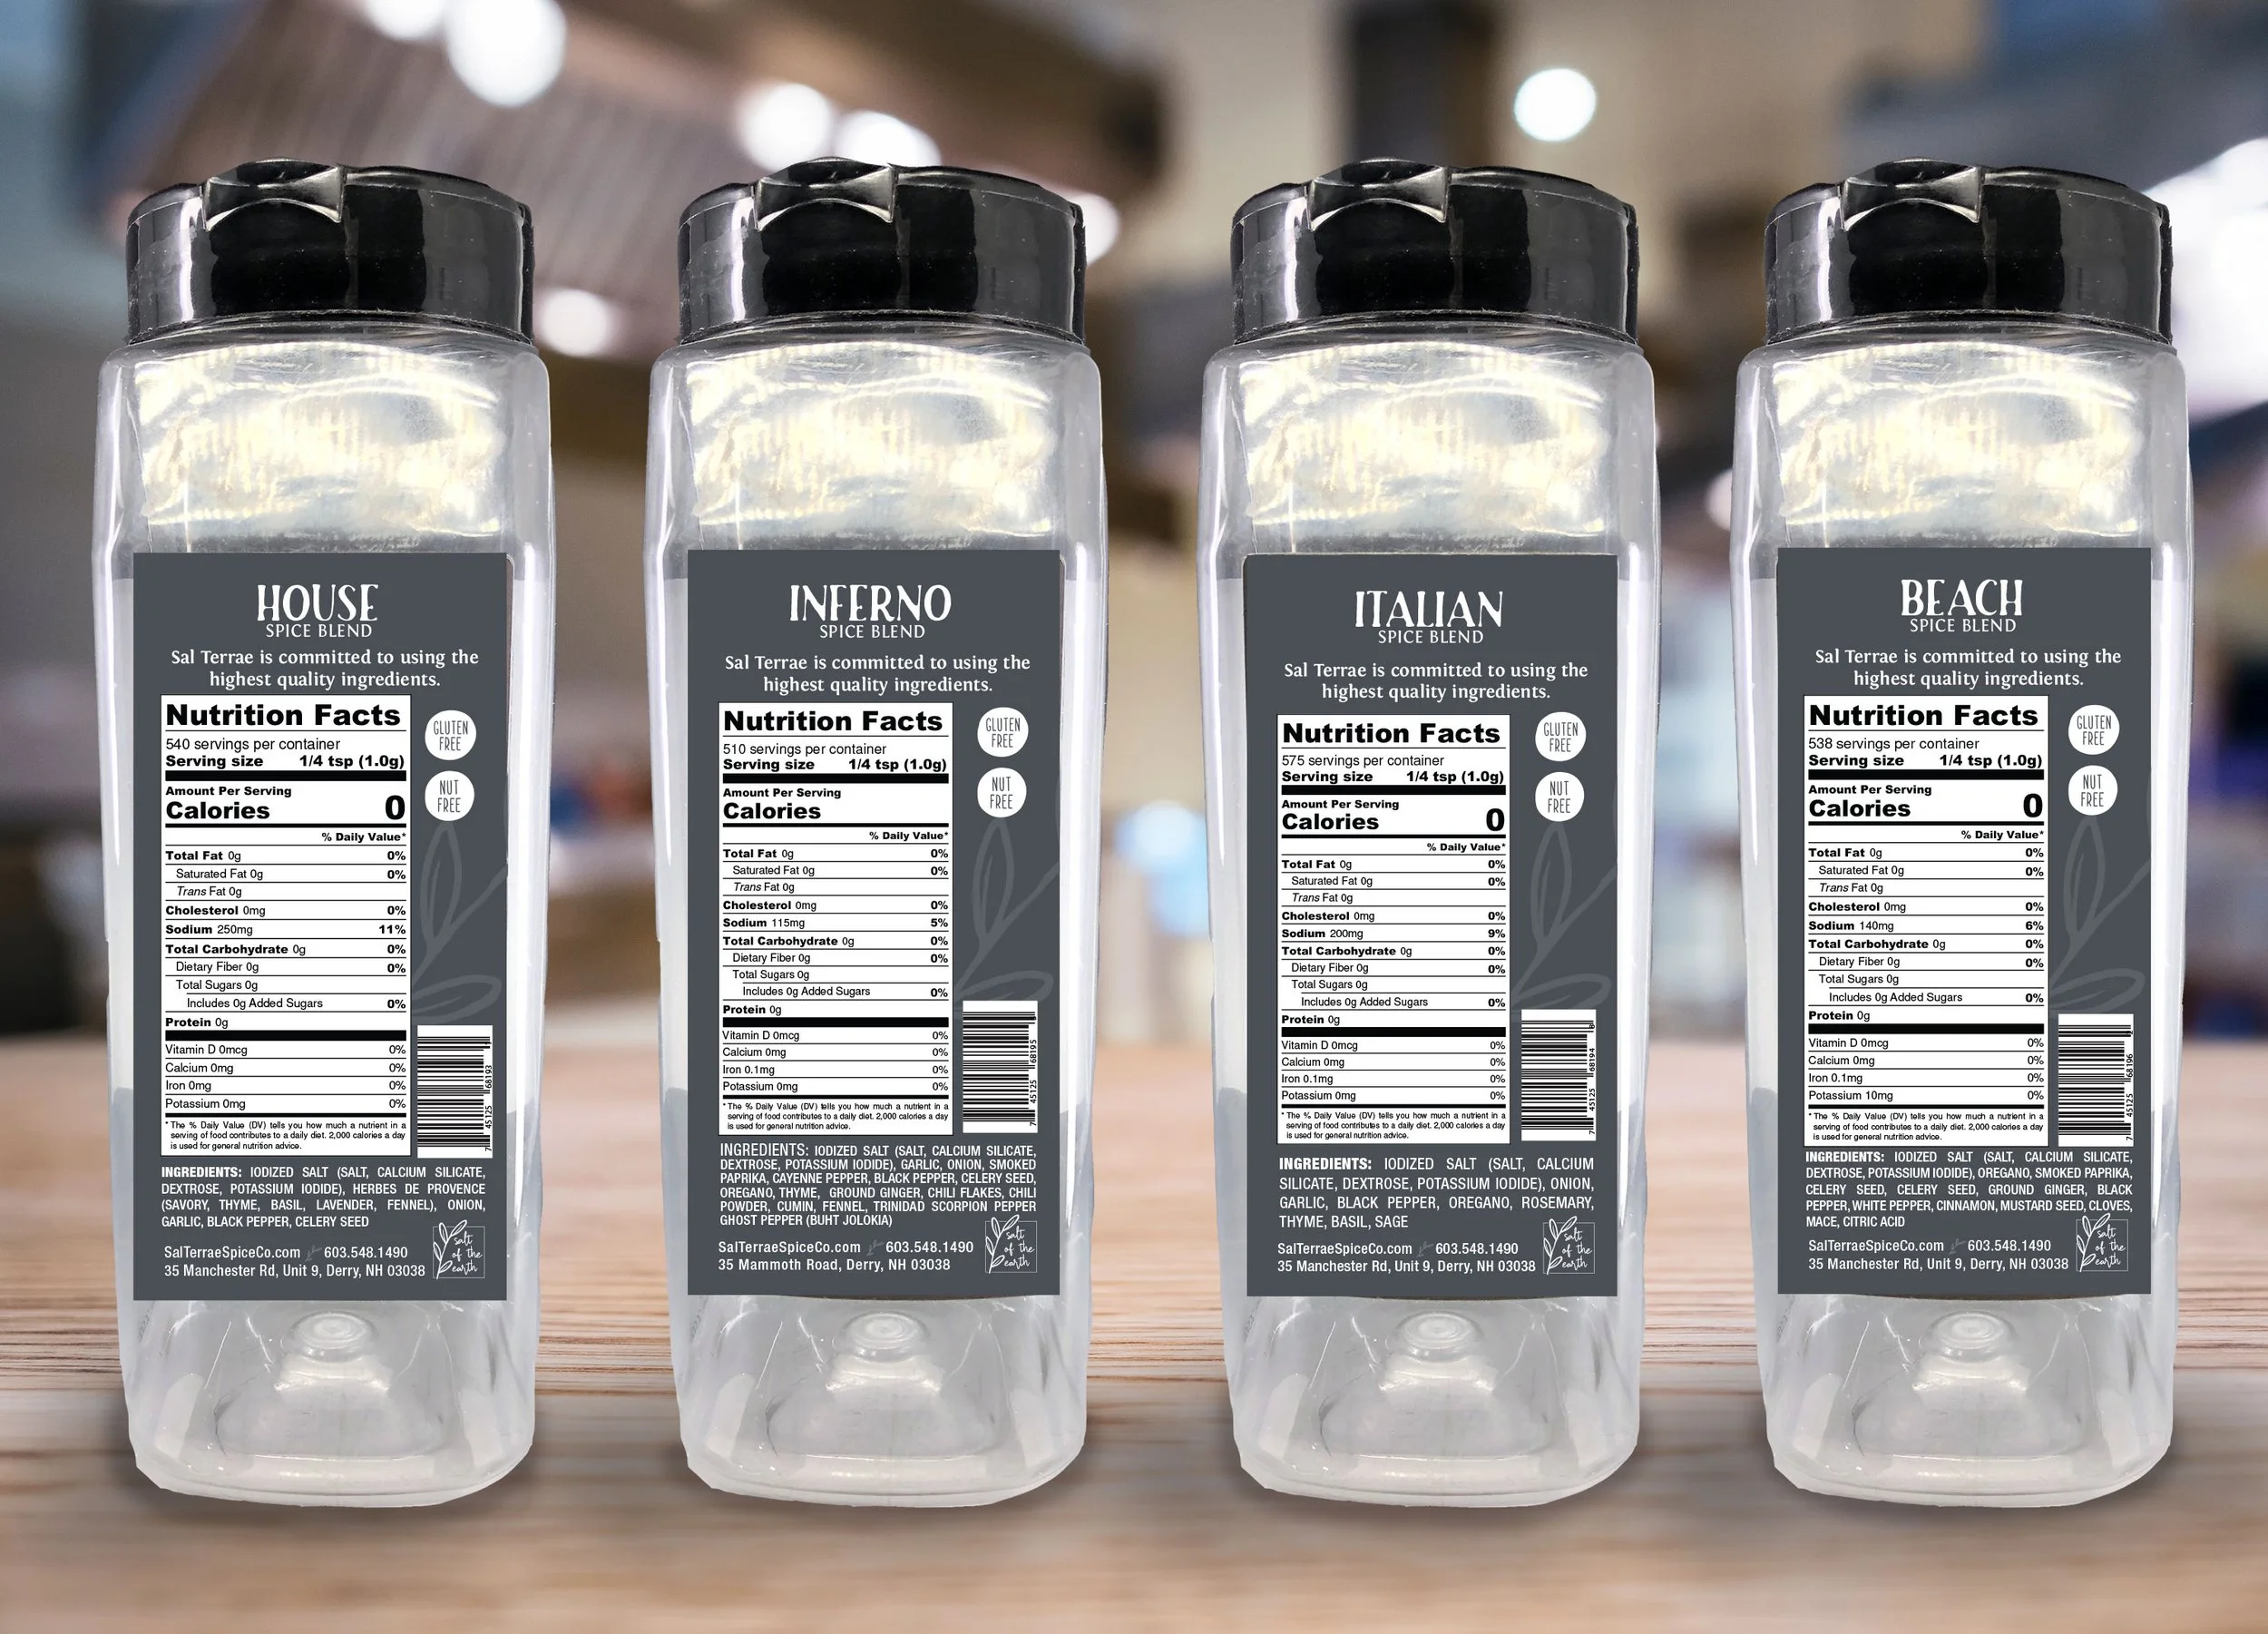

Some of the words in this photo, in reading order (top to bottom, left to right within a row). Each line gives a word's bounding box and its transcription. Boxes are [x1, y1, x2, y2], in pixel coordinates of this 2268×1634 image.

[258, 584, 378, 621] HOUSE
[790, 584, 951, 621] INFERNO
[1901, 579, 2022, 615] BEACH
[1355, 591, 1502, 627] ITALIAN
[266, 623, 311, 638] SPICE
[318, 623, 373, 638] BLEND
[819, 624, 865, 639] SPICE
[871, 624, 925, 639] BLEND
[1910, 618, 1955, 632] SPICE
[1962, 618, 2017, 632] BLEND
[1378, 630, 1423, 644] SPICE
[1430, 630, 1484, 644] BLEND
[171, 648, 195, 665] Sal
[200, 650, 254, 665] Terrae
[259, 649, 273, 665] is
[278, 648, 372, 665] committed
[376, 651, 395, 665] to
[400, 649, 446, 669] using
[451, 648, 479, 665] the
[209, 670, 272, 691] highest
[277, 670, 336, 691] quality
[341, 670, 441, 691] ingredients.
[1321, 682, 1384, 703] highest
[1388, 682, 1447, 703] quality
[1452, 682, 1550, 703] ingredients.
[166, 703, 303, 727] Nutrition
[315, 703, 401, 727] Facts
[724, 710, 852, 732] Nutrition
[862, 710, 943, 732] Facts
[433, 719, 469, 736] GLUTEN
[985, 717, 1021, 732] GLUTEN
[1543, 721, 1579, 737] GLUTEN
[1283, 722, 1410, 744] Nutrition
[1420, 722, 1501, 744] Facts
[165, 738, 191, 750] 540
[194, 738, 249, 754] servings
[253, 739, 276, 753] per
[279, 738, 341, 750] container
[439, 736, 462, 751] FREE
[991, 733, 1014, 749] FREE
[1549, 738, 1572, 753] FREE
[1808, 737, 1833, 749] 538
[1835, 737, 1891, 752] servings
[1894, 739, 1916, 752] per
[1919, 737, 1980, 749] container
[723, 743, 747, 755] 510
[749, 742, 802, 758] servings
[805, 745, 826, 758] per
[828, 742, 887, 755] container
[165, 754, 227, 770] Serving
[230, 754, 264, 768] size
[298, 754, 324, 768] 1/4
[327, 755, 354, 770] tsp
[358, 754, 405, 770] (1.0g)
[1282, 754, 1305, 767] 575
[1308, 754, 1360, 769] servings
[1363, 757, 1384, 769] per
[1387, 754, 1445, 767] container
[1808, 754, 1868, 769] Serving
[1872, 754, 1905, 767] size
[1939, 754, 1963, 767] 1/4
[1967, 754, 1993, 769] tsp
[1997, 754, 2043, 769] (1.0g)
[439, 779, 459, 796] NUT
[992, 776, 1012, 792] NUT
[2082, 773, 2103, 790] NUT
[722, 788, 770, 797] Amount
[772, 788, 794, 797] Per
[796, 788, 842, 800] Serving
[990, 793, 1013, 810] FREE
[2080, 791, 2105, 807] FREE
[165, 800, 270, 820] Calories
[385, 798, 406, 821] 0
[437, 797, 462, 813] FREE
[1280, 812, 1380, 831] Calories
[1485, 807, 1505, 832] 0
[722, 848, 754, 858] Total
[757, 848, 777, 858] Fat
[781, 848, 795, 861] 0g
[930, 848, 949, 858] 0%
[1426, 842, 1437, 852] %
[1440, 842, 1468, 854] Daily
[1818, 865, 1869, 876] Saturated
[1872, 865, 1889, 876] Fat
[1891, 865, 1905, 877] 0g
[2025, 866, 2045, 877] 0%
[722, 900, 792, 910] Cholesterol
[795, 900, 817, 913] 0mg
[930, 900, 949, 910] 0%
[165, 924, 213, 934] Sodium
[217, 924, 253, 937] 250mg
[378, 924, 406, 935] 11%
[1291, 962, 1326, 974] Dietary
[1328, 962, 1354, 973] Fiber
[1355, 963, 1369, 974] 0g
[1487, 964, 1506, 974] 0%
[742, 985, 784, 996] Includes
[786, 986, 798, 999] 0g
[800, 985, 834, 996] Added
[836, 985, 871, 999] Sugars
[930, 987, 949, 998] 0%
[1281, 1014, 1325, 1024] Protein
[1327, 1014, 1341, 1027] 0g
[1280, 1040, 1318, 1051] Vitamin
[1321, 1040, 1329, 1051] D
[1331, 1041, 1358, 1052] 0mcg
[1490, 1040, 1506, 1050] 0%
[1808, 1090, 1862, 1101] Potassium
[1865, 1090, 1893, 1103] 10mg
[2027, 1090, 2045, 1101] 0%
[1813, 1132, 1821, 1140] is
[1821, 1132, 1841, 1140] used
[1841, 1132, 1853, 1140] for
[1853, 1132, 1882, 1142] general
[1883, 1132, 1914, 1140] nutrition
[1915, 1132, 1942, 1140] advice.
[161, 1216, 204, 1229] GARLIC,
[207, 1216, 244, 1228] BLACK
[246, 1216, 292, 1229] PEPPER,
[295, 1216, 337, 1228] CELERY
[339, 1216, 369, 1228] SEED
[719, 1214, 758, 1226] GHOST
[760, 1214, 803, 1226] PEPPER
[806, 1214, 840, 1228] (BUHT
[842, 1214, 893, 1228] JOLOKIA)
[1278, 1215, 1327, 1230] THYME,
[1331, 1215, 1372, 1230] BASIL,
[1374, 1215, 1409, 1228] SAGE
[1805, 1216, 1840, 1229] MACE,
[1843, 1216, 1878, 1228] CITRIC
[1879, 1216, 1906, 1228] ACID
[164, 1245, 301, 1259] SalTerraeSpiceCo.com
[324, 1246, 408, 1258] 603.548.1490
[718, 1258, 734, 1271] 35
[738, 1258, 801, 1271] Mammoth
[807, 1258, 842, 1273] Road,
[846, 1258, 884, 1273] Derry,
[888, 1258, 906, 1271] NH
[911, 1258, 951, 1271] 03038
[1277, 1259, 1293, 1272] 35
[1296, 1259, 1368, 1272] Manchester
[1372, 1259, 1392, 1275] Rd,
[1394, 1259, 1420, 1272] Unit
[1422, 1259, 1434, 1275] 9,
[1437, 1259, 1473, 1275] Derry,
[1476, 1259, 1494, 1272] NH
[1497, 1259, 1536, 1272] 03038
